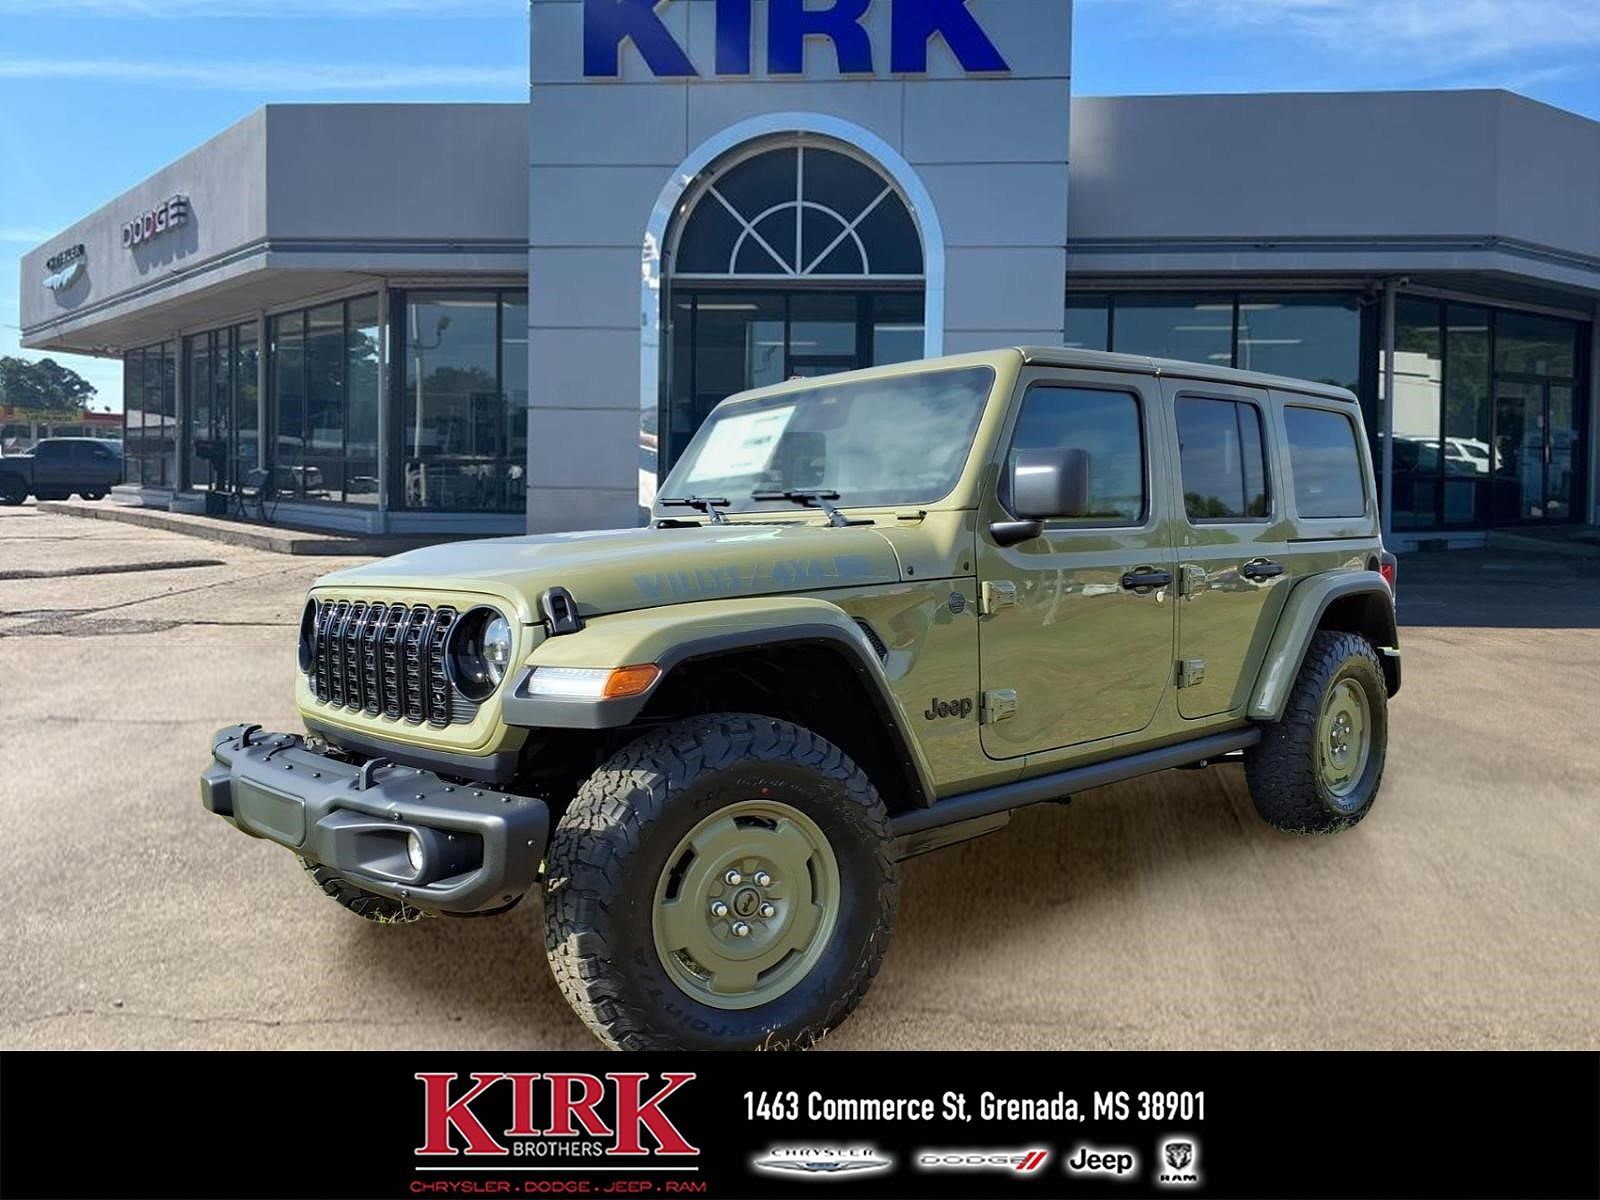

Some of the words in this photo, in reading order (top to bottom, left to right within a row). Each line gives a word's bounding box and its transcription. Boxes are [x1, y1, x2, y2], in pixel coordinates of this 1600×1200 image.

[583, 0, 1011, 76] KIRK
[121, 192, 190, 249] DODGE
[924, 697, 972, 720] Jeep
